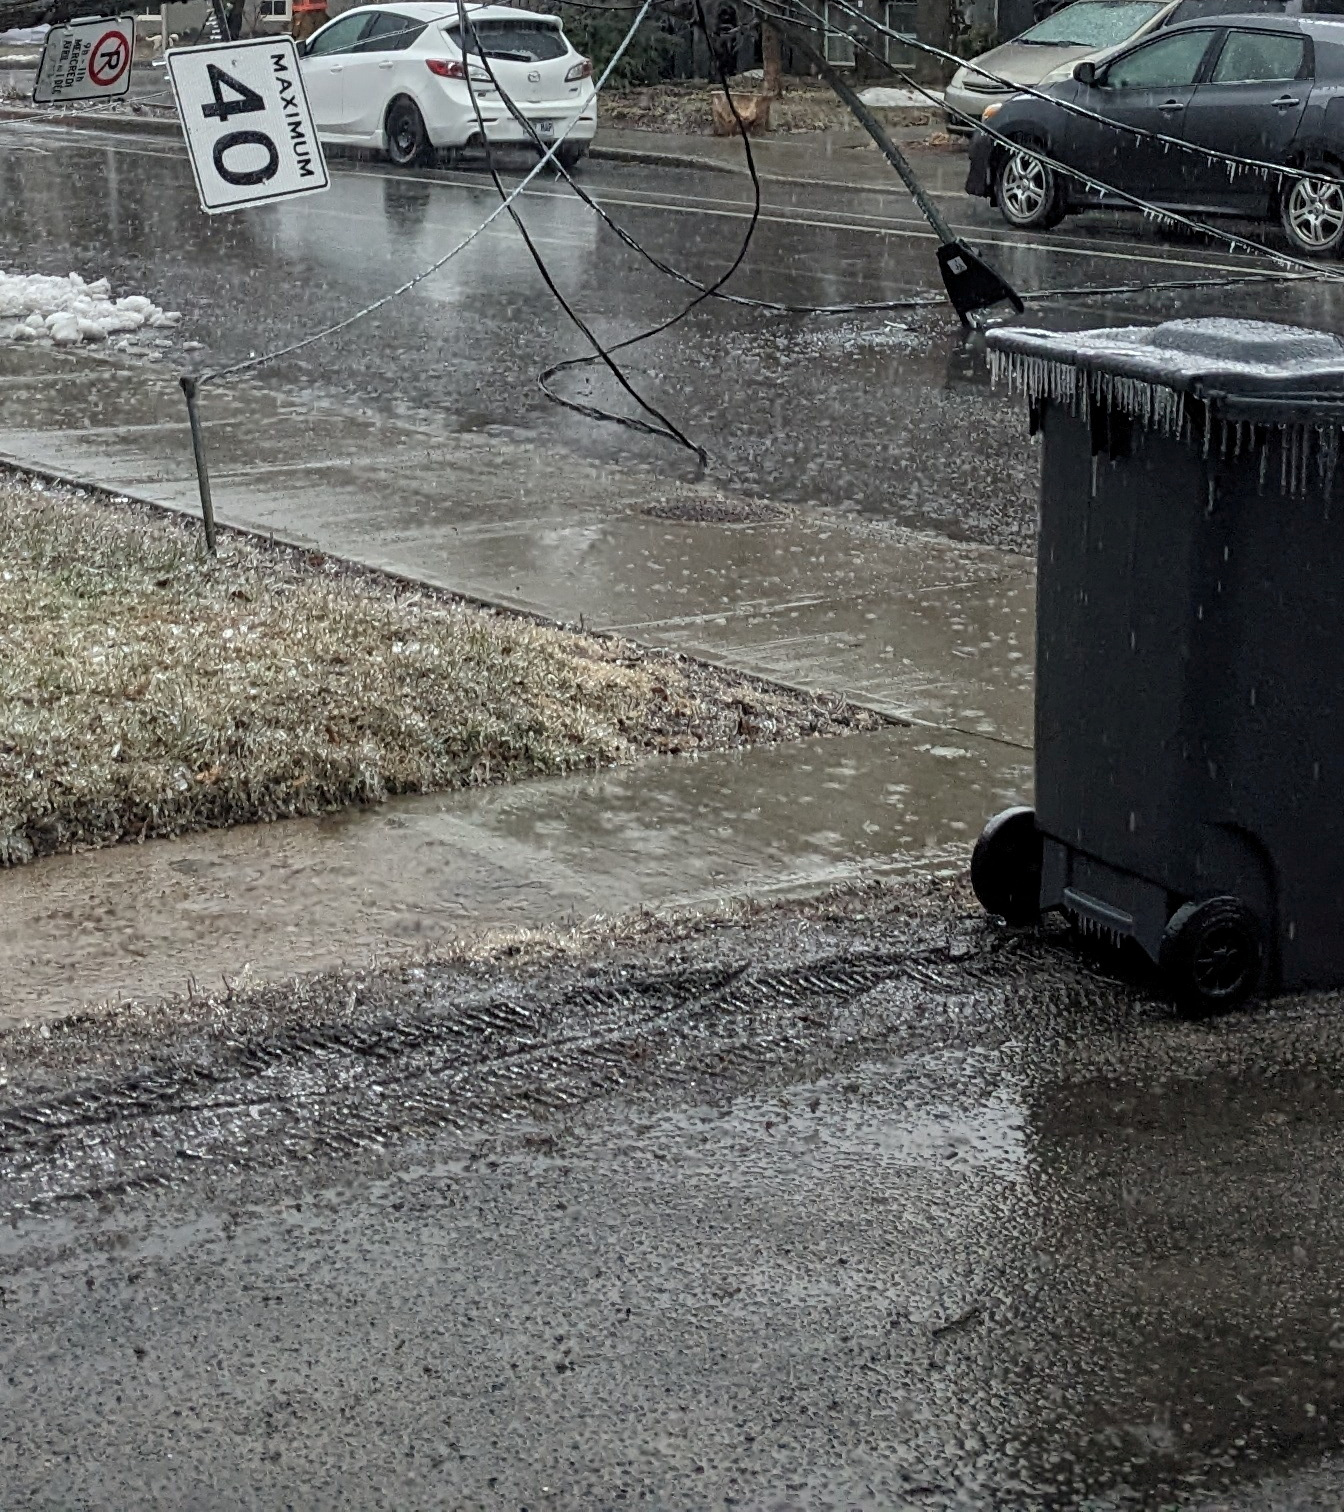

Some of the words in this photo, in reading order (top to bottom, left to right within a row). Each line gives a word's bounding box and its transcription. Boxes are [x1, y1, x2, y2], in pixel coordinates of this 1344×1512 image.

[63, 38, 83, 88] MERCREDI
[201, 63, 279, 186] 40
[270, 53, 315, 178] MAXIMUM
